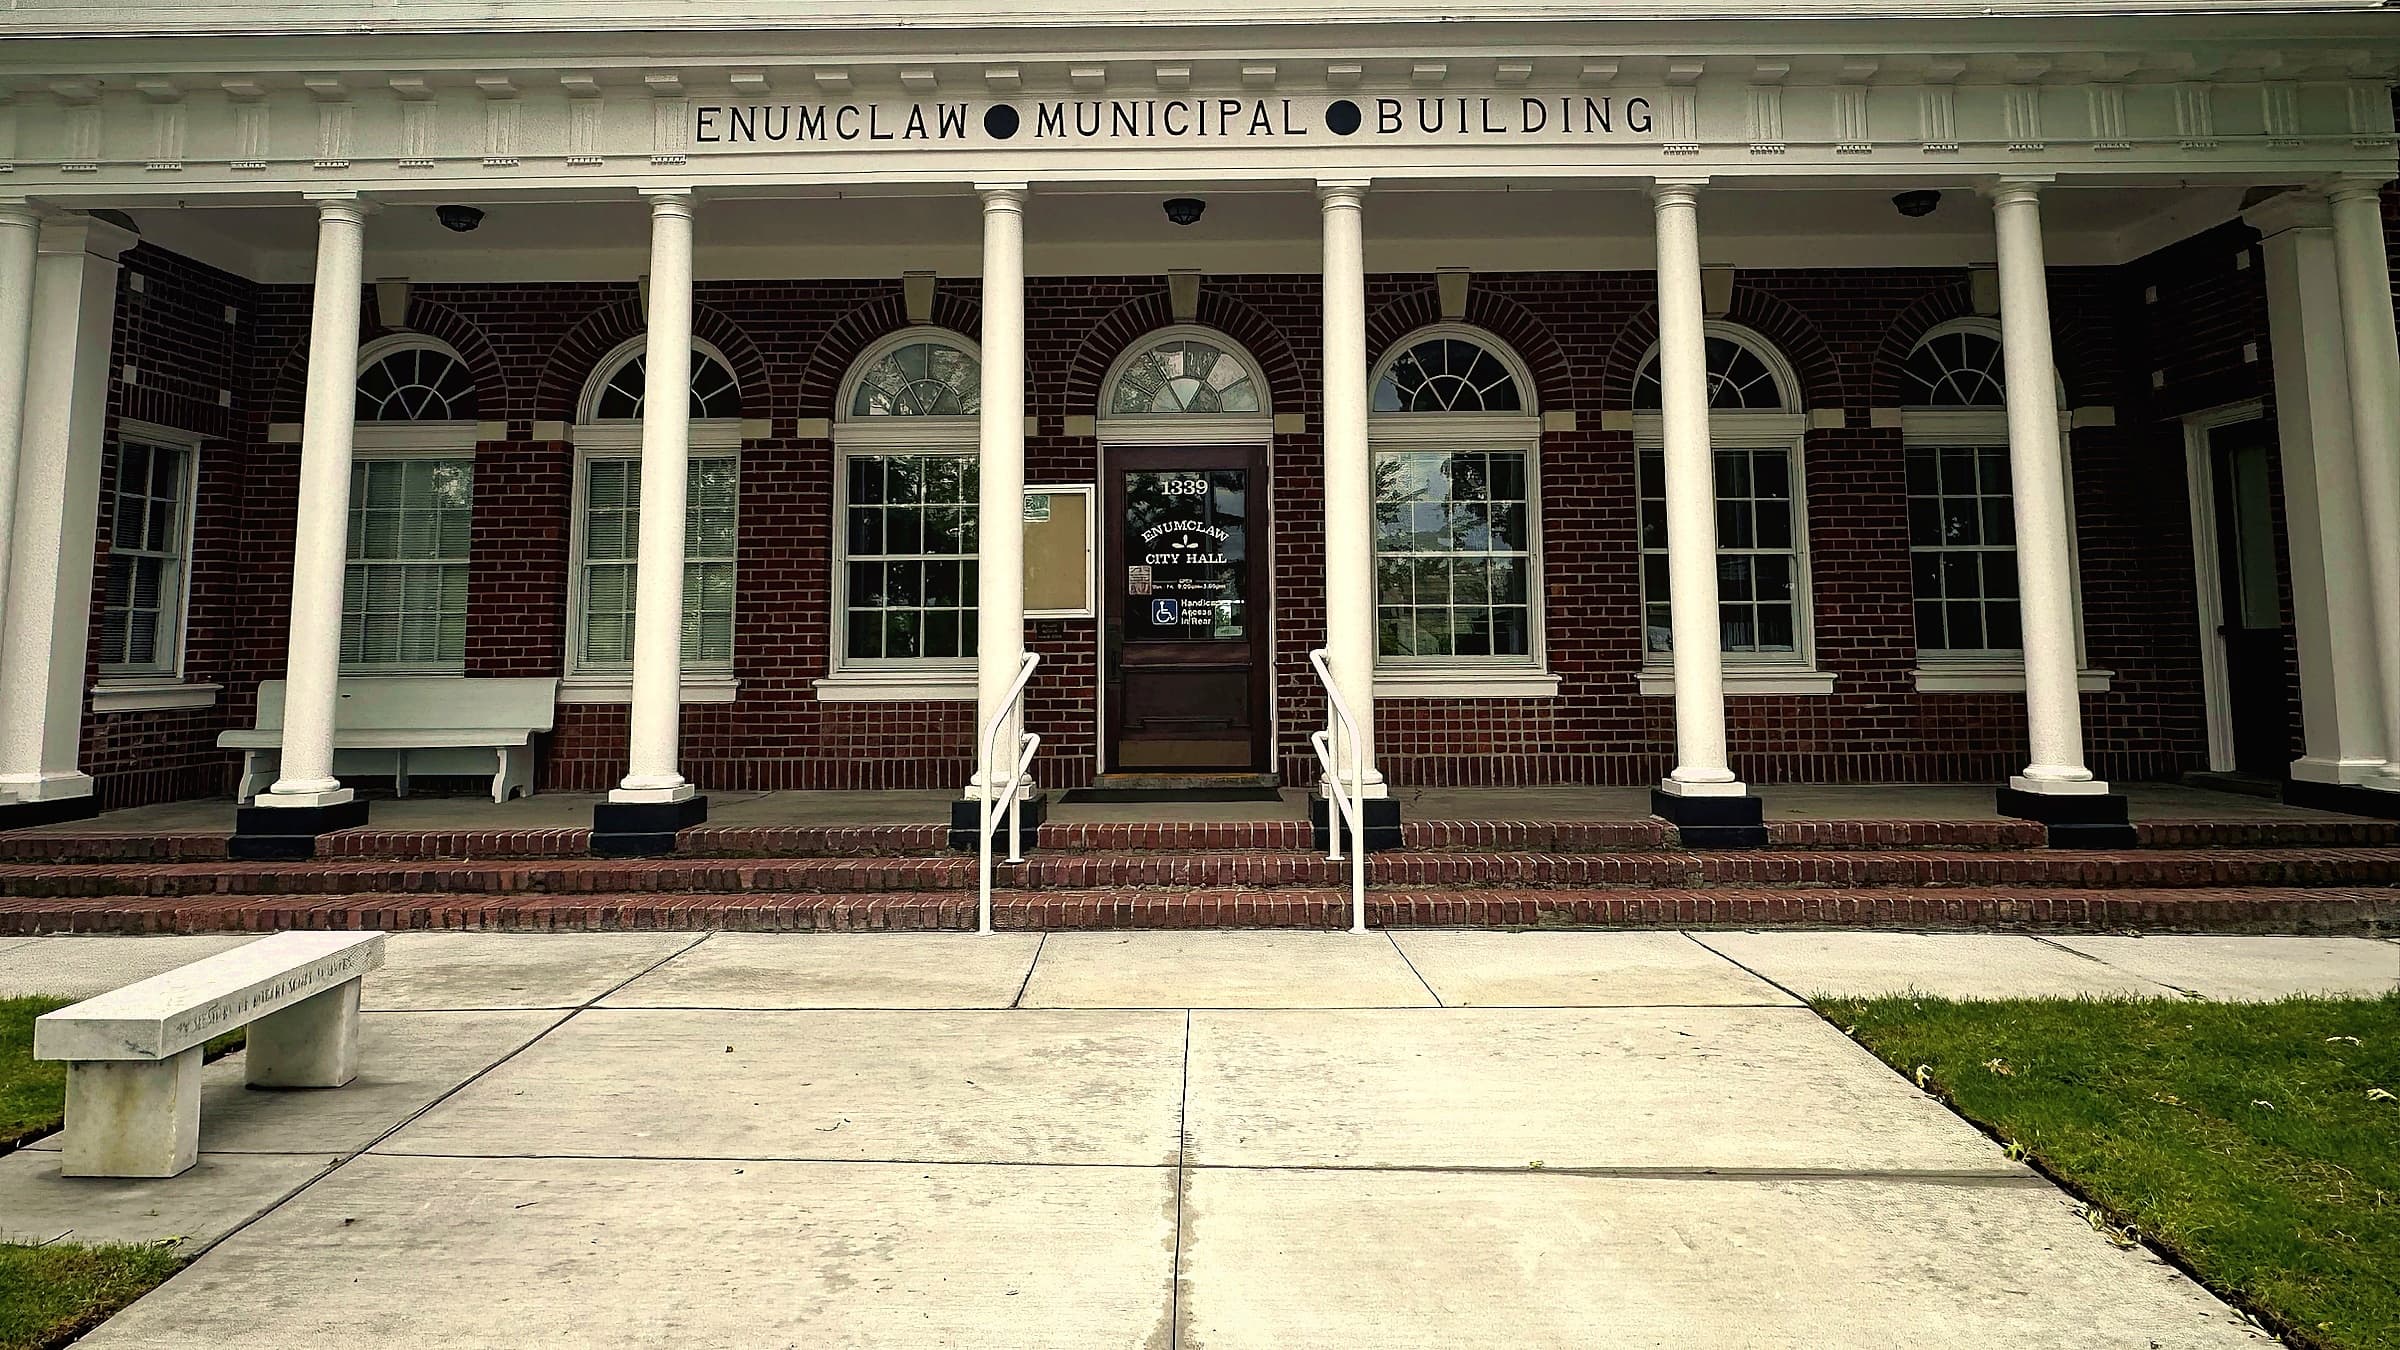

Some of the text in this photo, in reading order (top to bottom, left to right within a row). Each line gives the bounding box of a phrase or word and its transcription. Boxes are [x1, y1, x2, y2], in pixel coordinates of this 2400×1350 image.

[697, 96, 1653, 141] ENUMCLAW MUNICIPAL BUILDING
[1161, 480, 1208, 495] 1339
[1141, 520, 1230, 542] ENUMCLAW
[1145, 553, 1227, 564] CITY HALL
